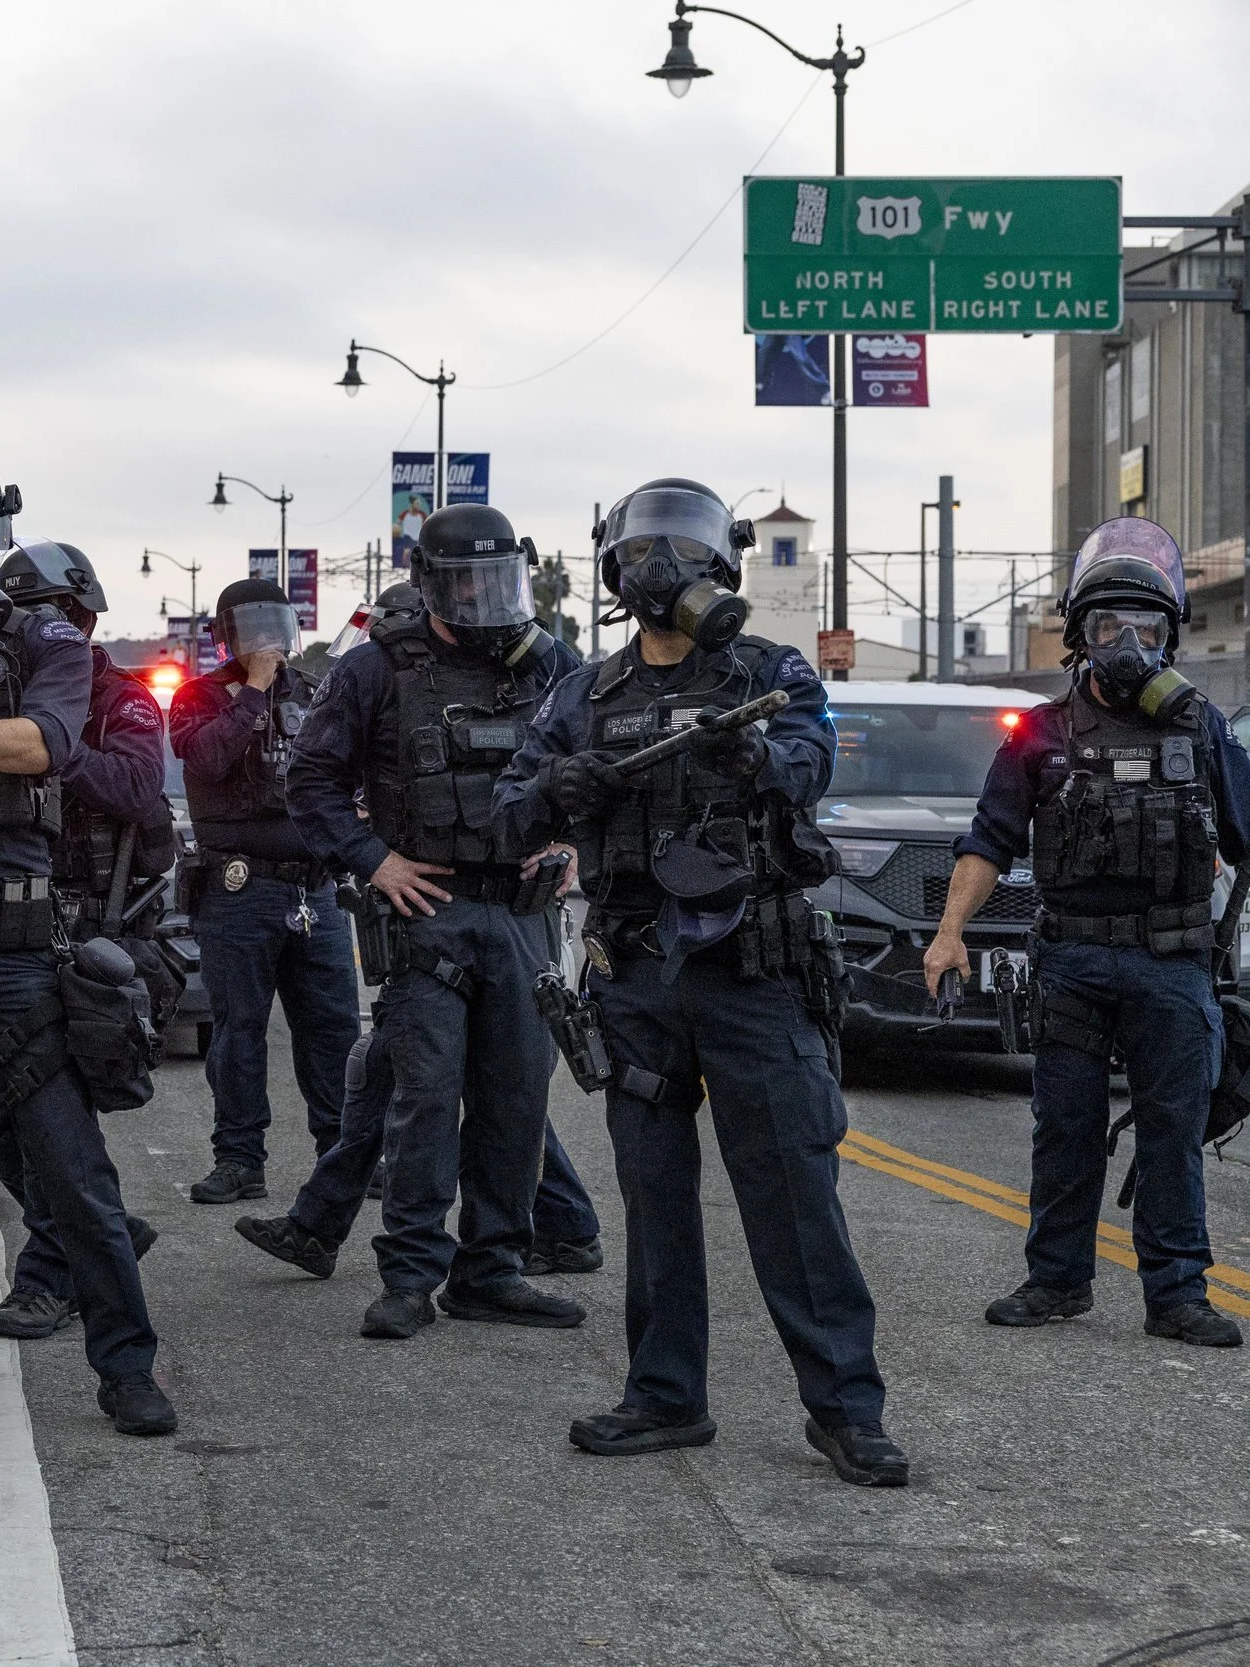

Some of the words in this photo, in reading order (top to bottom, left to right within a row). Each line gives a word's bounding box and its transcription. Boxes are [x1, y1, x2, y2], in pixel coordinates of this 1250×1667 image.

[869, 205, 911, 228] 101
[944, 206, 1014, 235] Fwy
[795, 271, 884, 290] NORTH
[983, 271, 1073, 290] SOUTH
[761, 300, 826, 319] LEFT
[842, 300, 916, 319] LANE
[943, 300, 1021, 319] RIGHT
[1035, 300, 1109, 319] LANE
[393, 464, 434, 484] GAME
[447, 465, 475, 484] ON!
[475, 539, 495, 551] GUYER
[5, 576, 21, 588] MUY
[781, 663, 792, 677] LOS
[607, 719, 621, 728] LOS
[479, 737, 509, 745] POLICE
[1109, 748, 1153, 759] FITZGERALD
[1007, 872, 1032, 883] Ford
